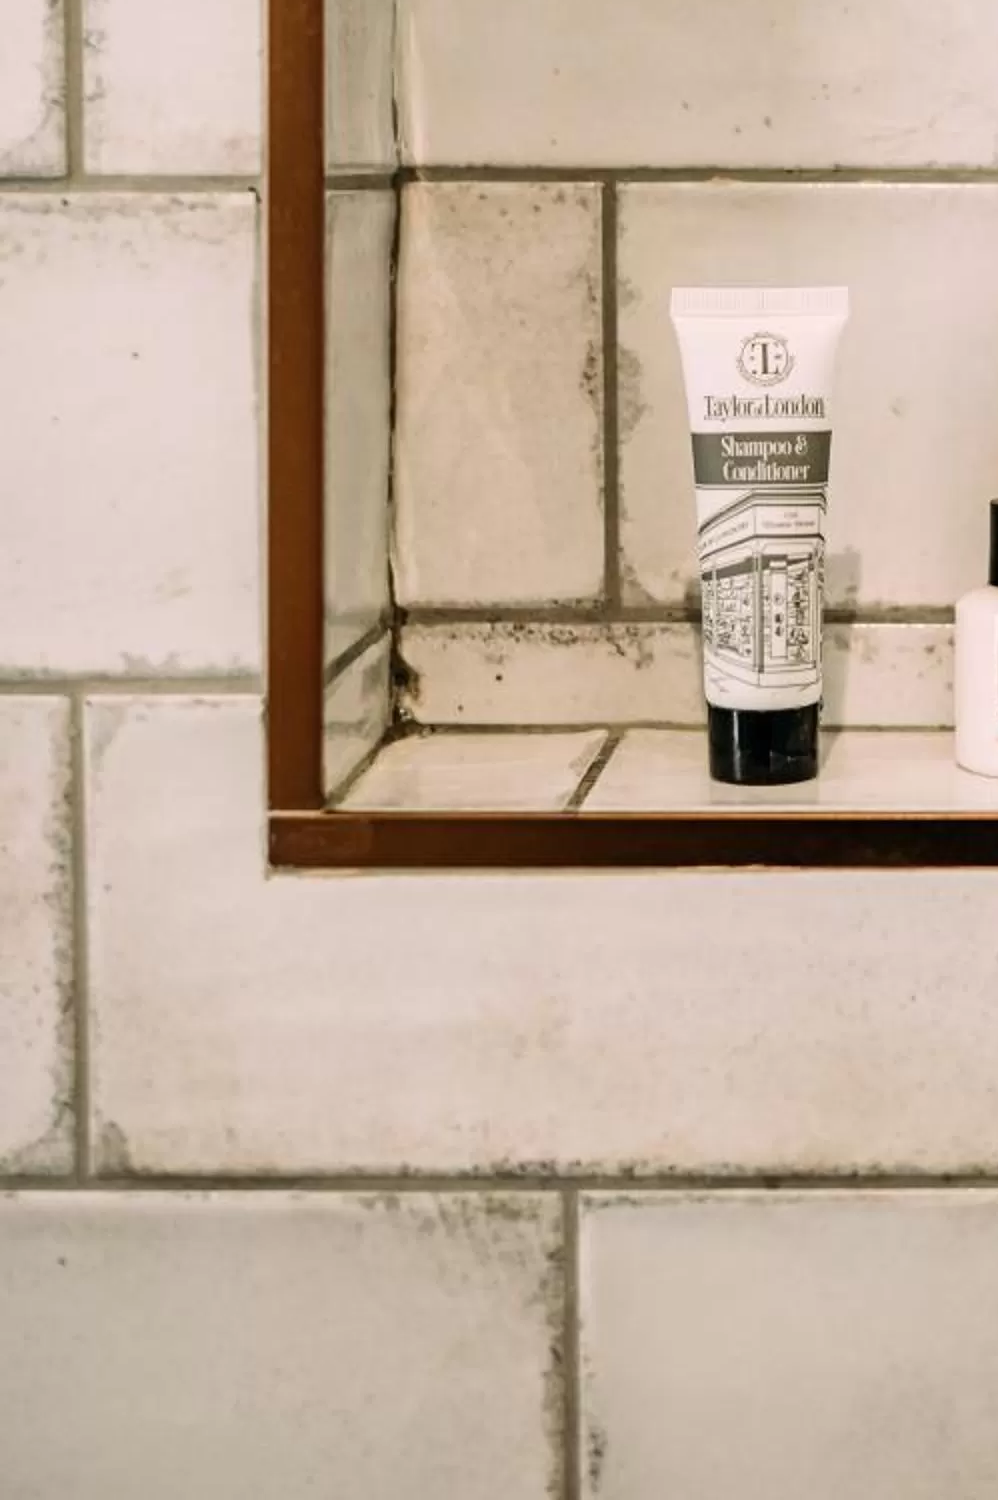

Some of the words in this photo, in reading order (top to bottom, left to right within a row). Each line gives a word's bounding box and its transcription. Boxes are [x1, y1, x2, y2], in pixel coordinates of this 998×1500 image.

[703, 394, 754, 422] Taylor
[762, 394, 825, 418] London
[720, 435, 792, 461] Shampoo
[794, 434, 808, 455] &
[722, 459, 811, 481] Conditioner
